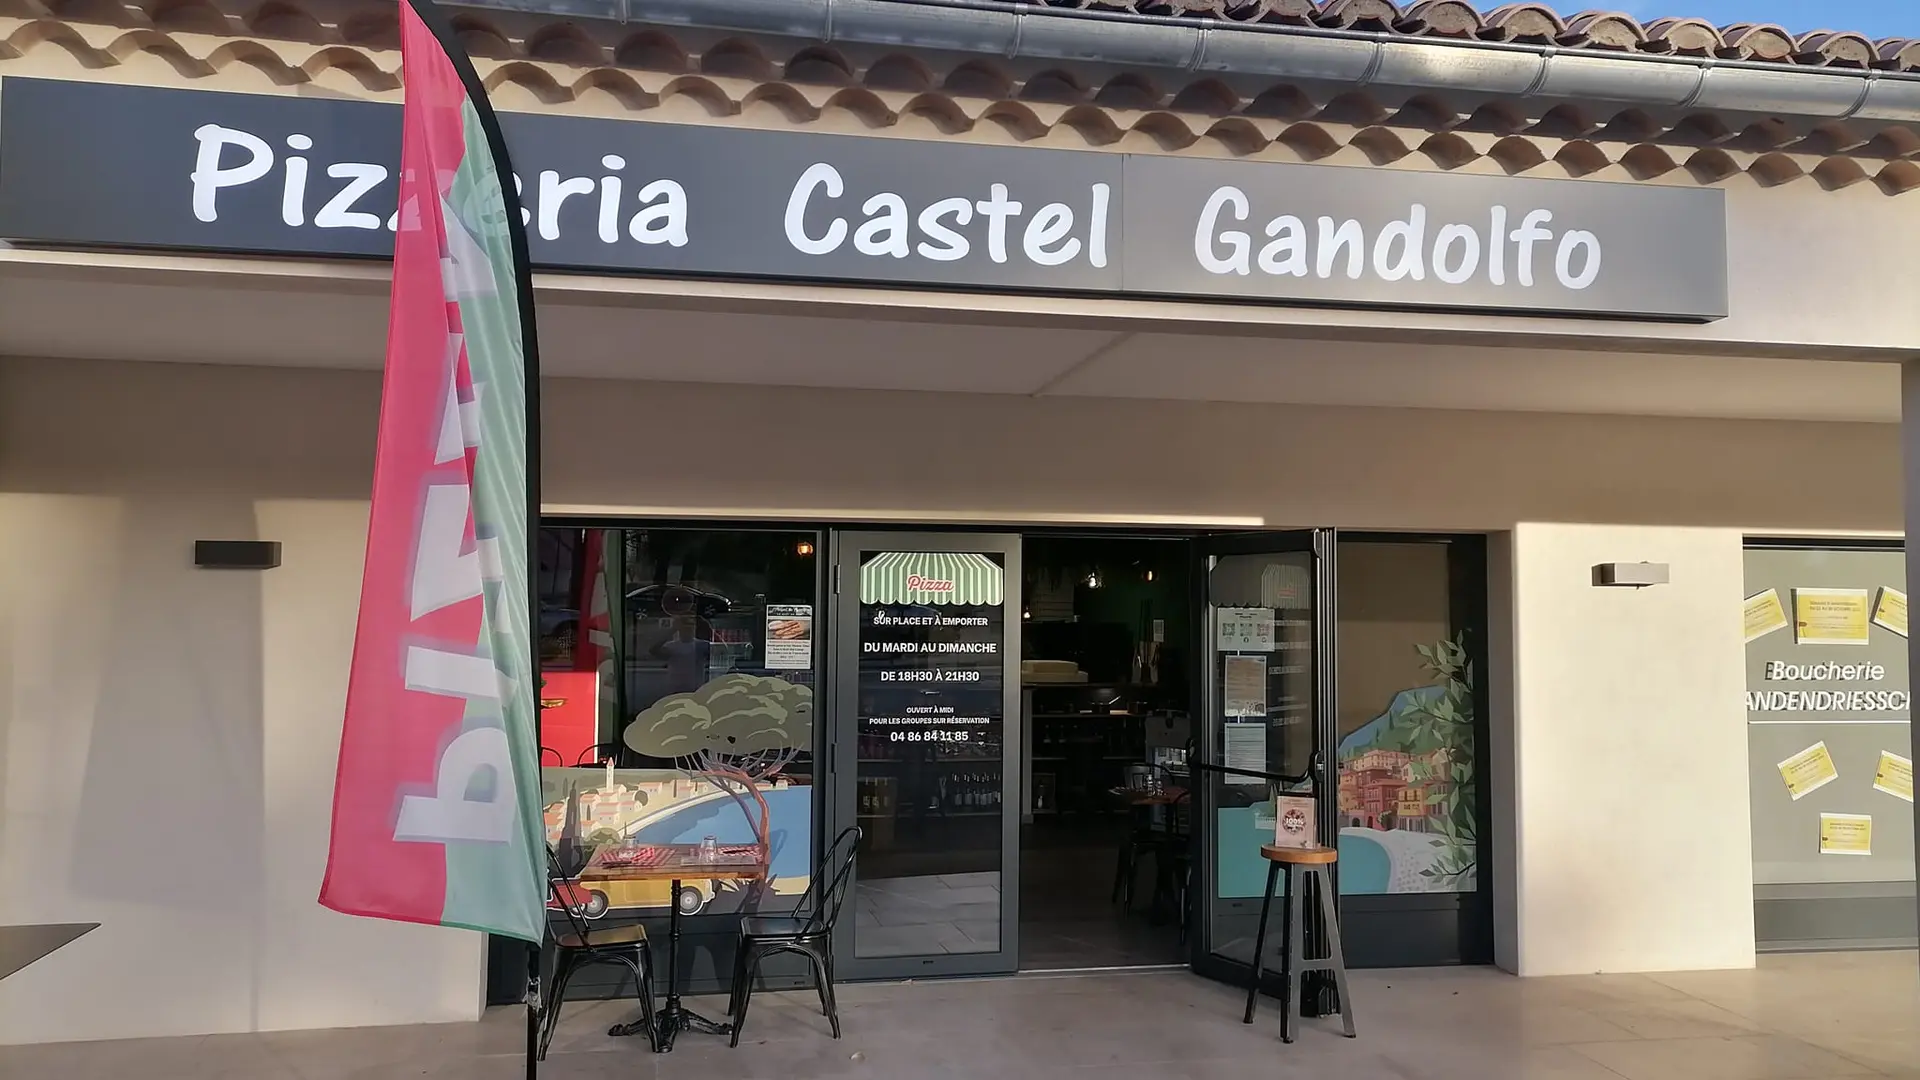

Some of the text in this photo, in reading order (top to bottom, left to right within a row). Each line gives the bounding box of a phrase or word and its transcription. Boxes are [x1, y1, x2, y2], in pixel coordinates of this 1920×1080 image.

[784, 163, 1110, 268] Castel
[1194, 186, 1602, 290] Gandolfo
[907, 574, 955, 592] Pizza
[874, 614, 989, 626] SUR PLACE ET À EMPORTER
[864, 642, 997, 653] DU MARDI AU DIMANCHE
[880, 668, 980, 681] DE 18H30 À 21H30
[1771, 660, 1886, 681] Boucherie
[1744, 690, 1911, 711] ANDENDRIESSC
[906, 705, 954, 714] OUVERT À MIDI
[869, 715, 990, 725] POUR LES GROUPES SUR RÉSERVATION
[890, 731, 969, 742] 04 86 84 11 85
